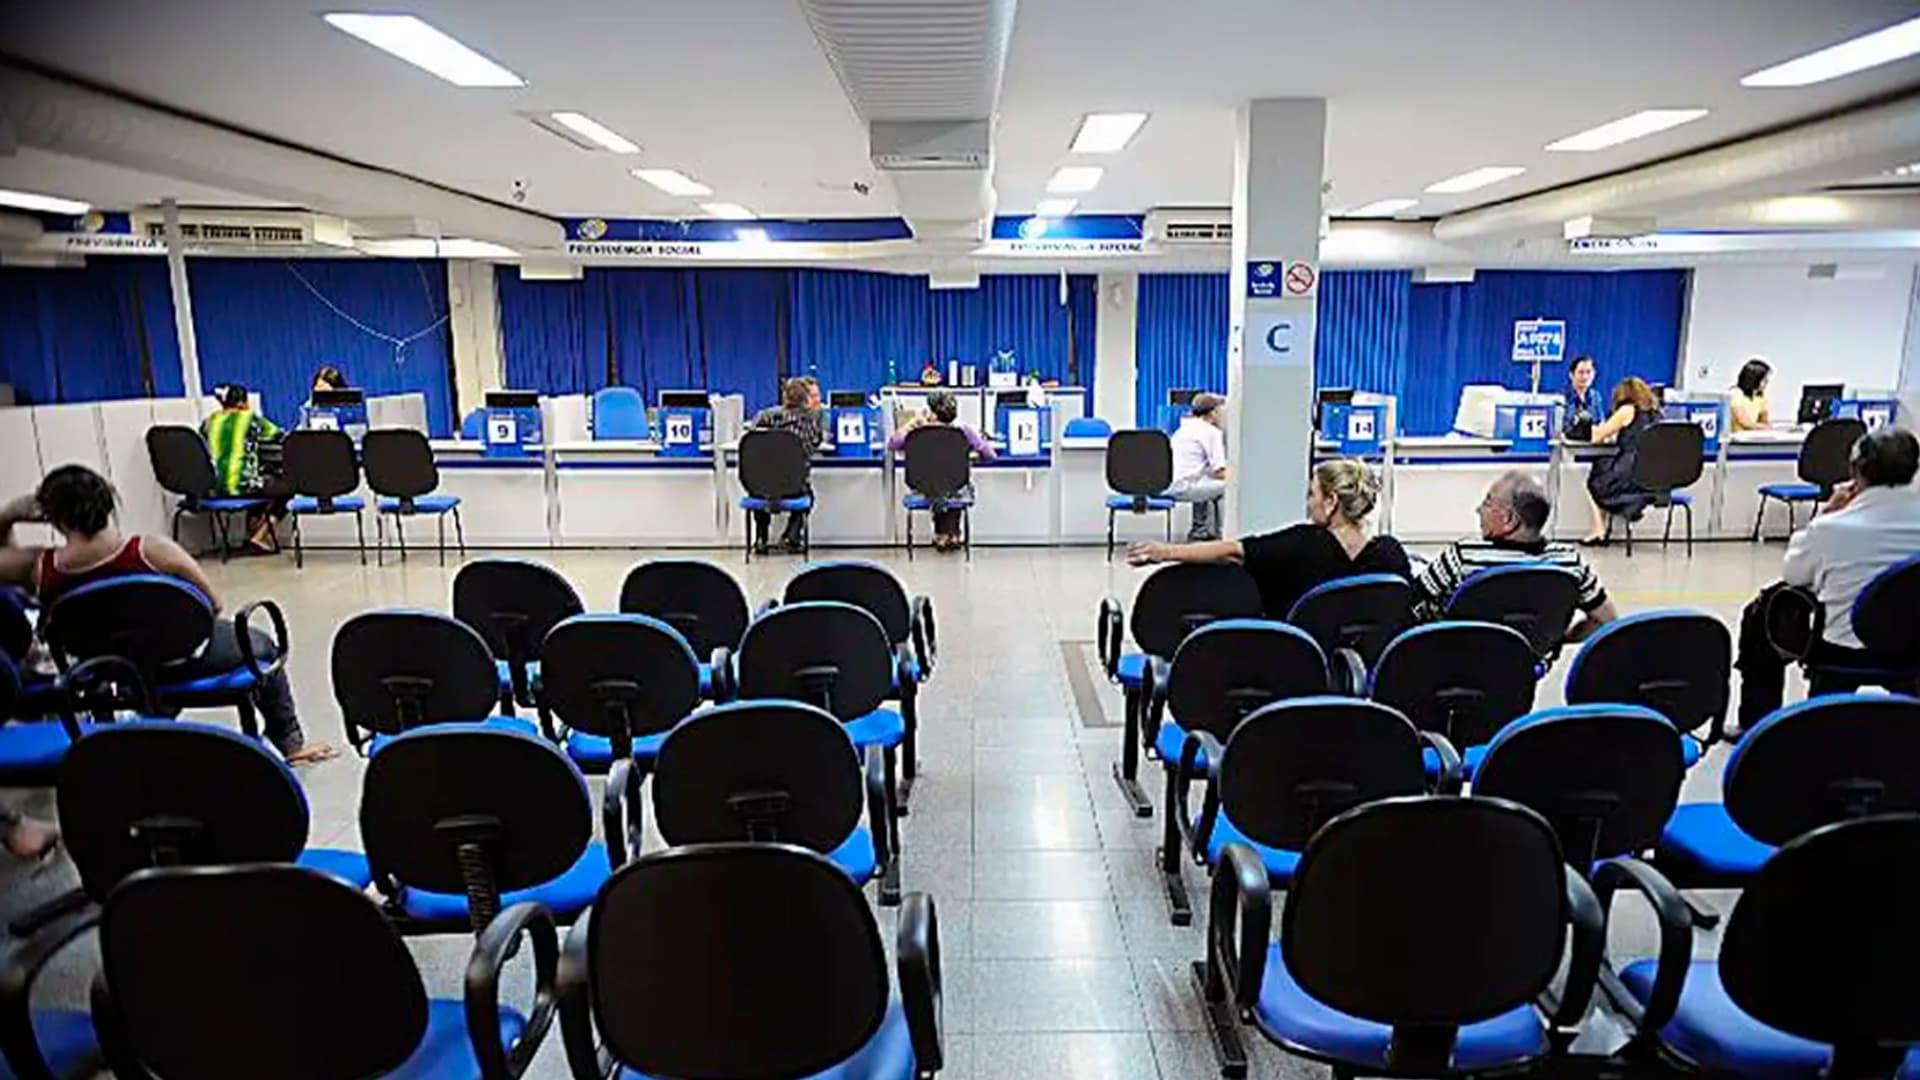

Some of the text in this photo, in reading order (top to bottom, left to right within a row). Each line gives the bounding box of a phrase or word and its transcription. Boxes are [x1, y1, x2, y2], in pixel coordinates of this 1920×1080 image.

[1266, 323, 1290, 352] C
[497, 424, 509, 439] 9
[671, 424, 690, 439] 10
[843, 424, 861, 437] 11
[1018, 423, 1033, 441] 12
[1355, 421, 1372, 434] 14
